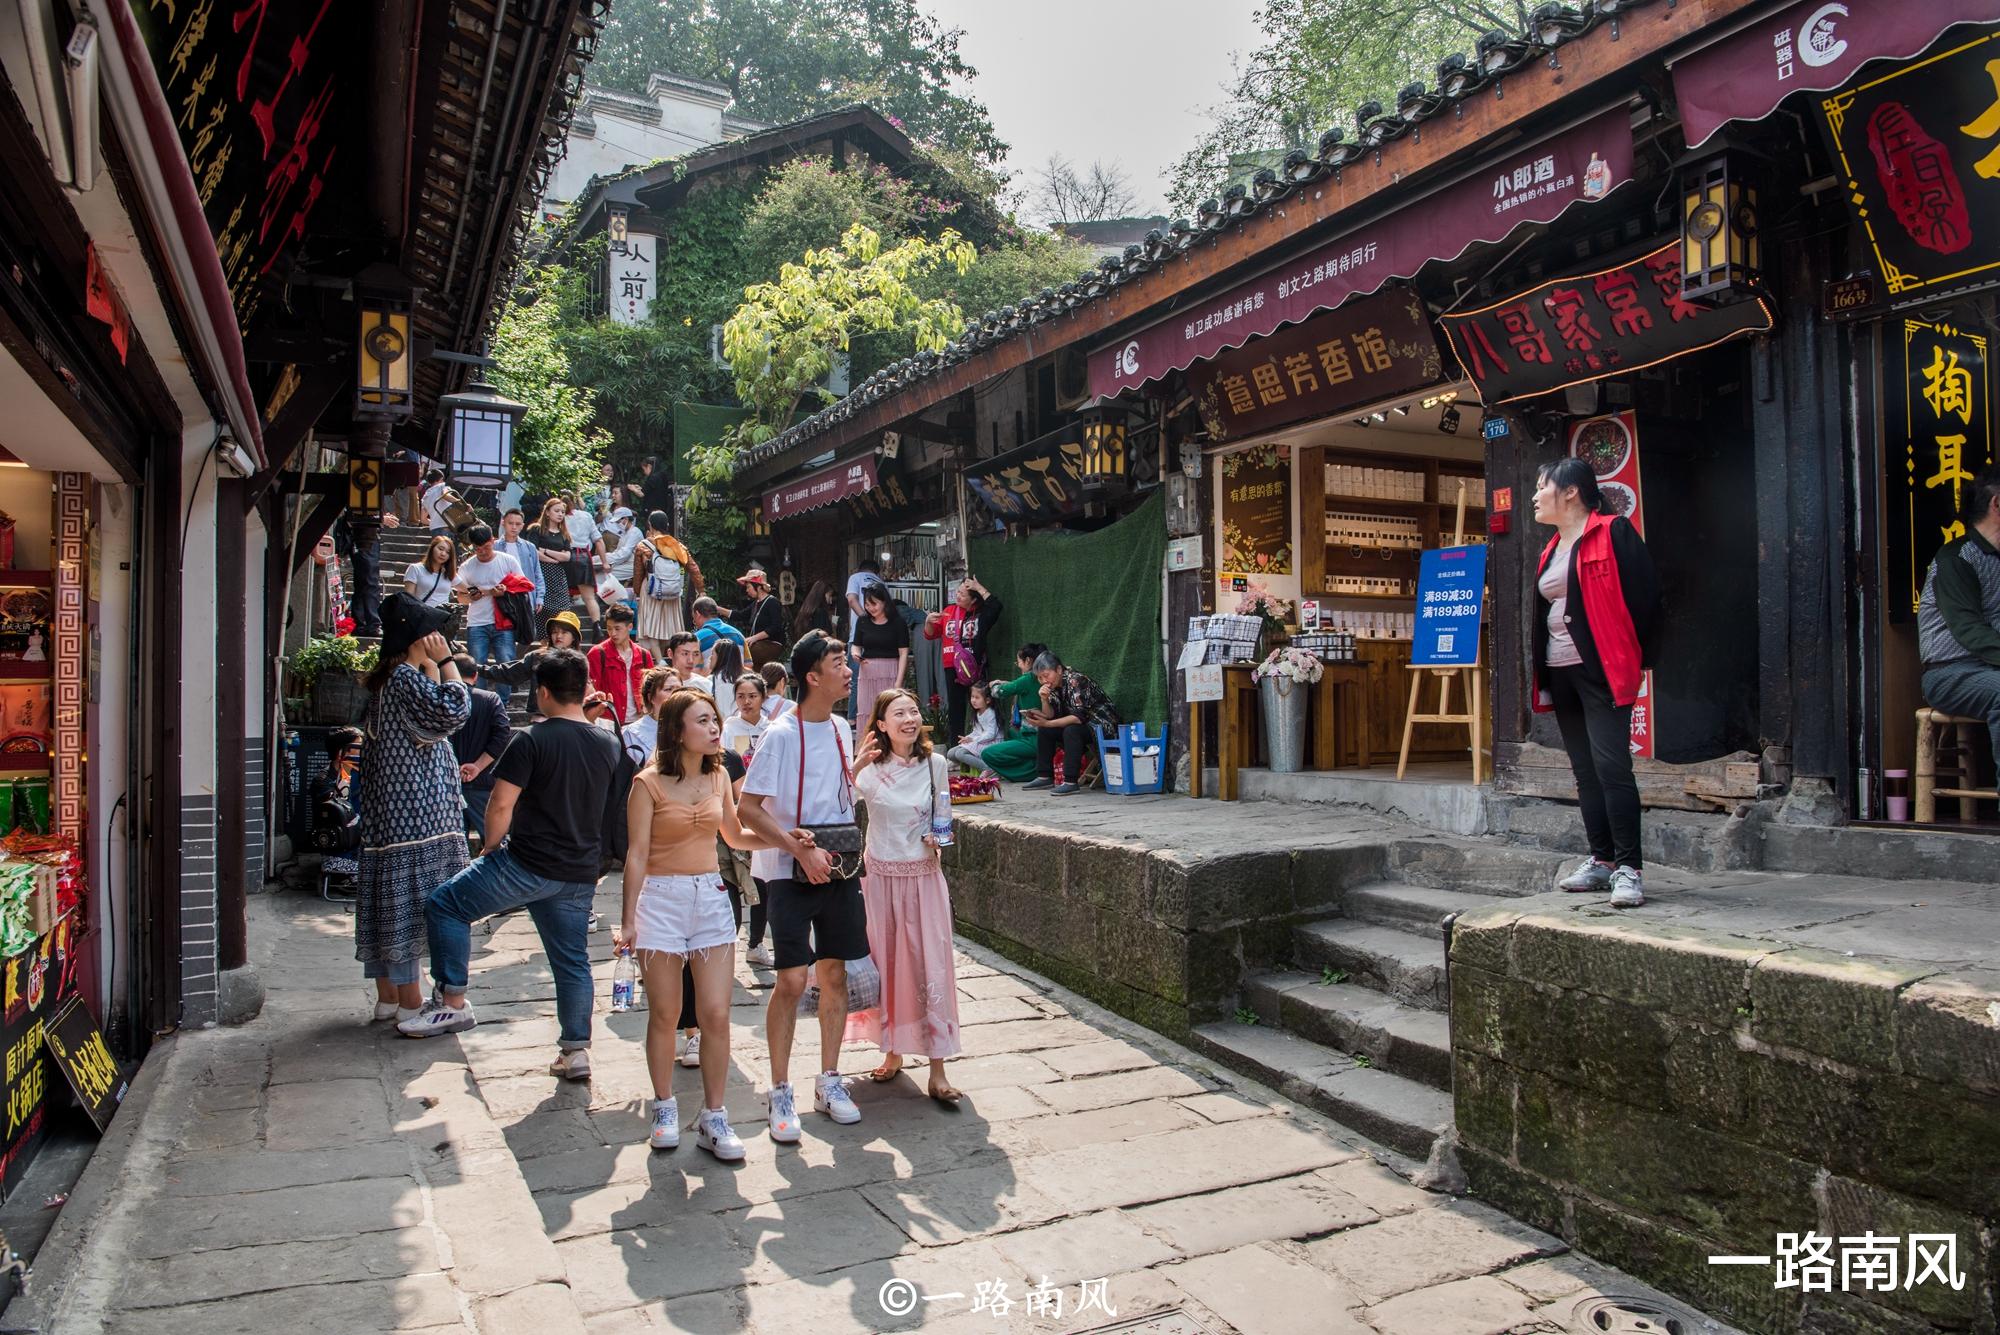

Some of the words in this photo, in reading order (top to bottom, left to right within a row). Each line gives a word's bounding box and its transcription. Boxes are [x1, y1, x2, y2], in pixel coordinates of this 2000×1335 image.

[1773, 28, 1794, 81] 磁器口
[1493, 154, 1555, 199] 小郎酒
[1494, 174, 1575, 214] 全国热销的小瓶白酒
[1184, 291, 1265, 340] 创卫成功感谢有您
[1278, 241, 1378, 299] 创文之路期待同行
[1833, 289, 1868, 309] 166号
[1222, 327, 1393, 416] 意思芳香馆
[1489, 424, 1504, 437] 170
[1422, 604, 1477, 619] 满189减80
[1424, 589, 1473, 604] 满89减30
